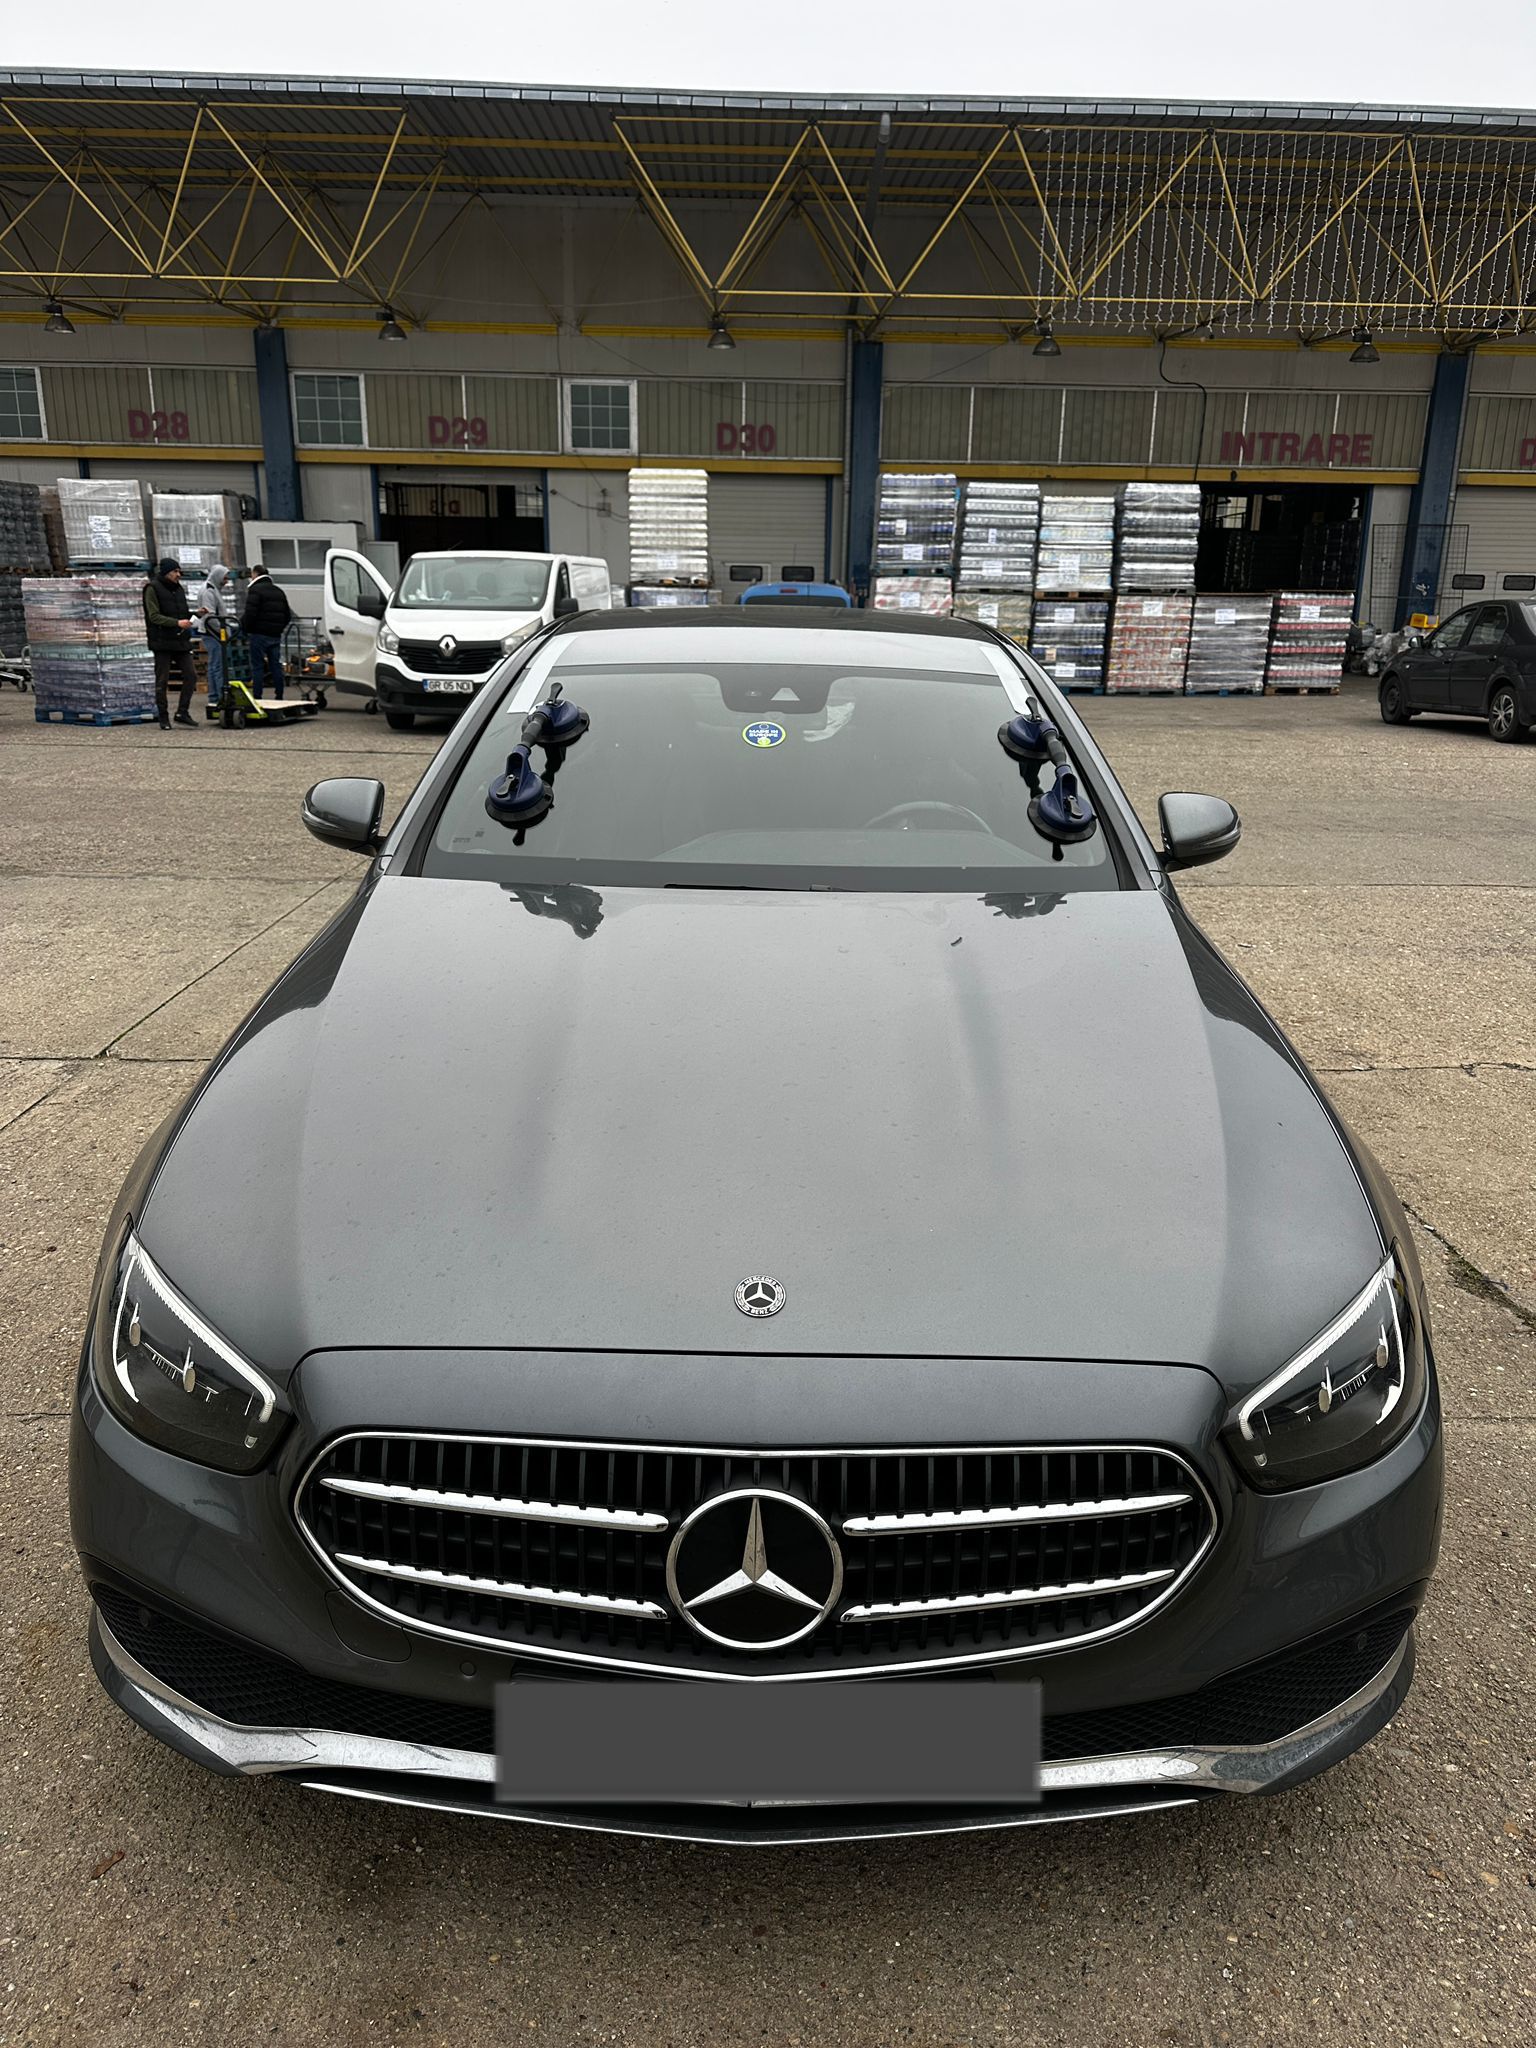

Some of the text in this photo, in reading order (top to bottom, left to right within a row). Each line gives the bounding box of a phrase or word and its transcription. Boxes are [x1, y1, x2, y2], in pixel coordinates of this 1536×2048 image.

[128, 410, 189, 440] D28
[428, 416, 488, 446] D29
[717, 422, 776, 452] D30
[1220, 431, 1374, 464] INTRARE
